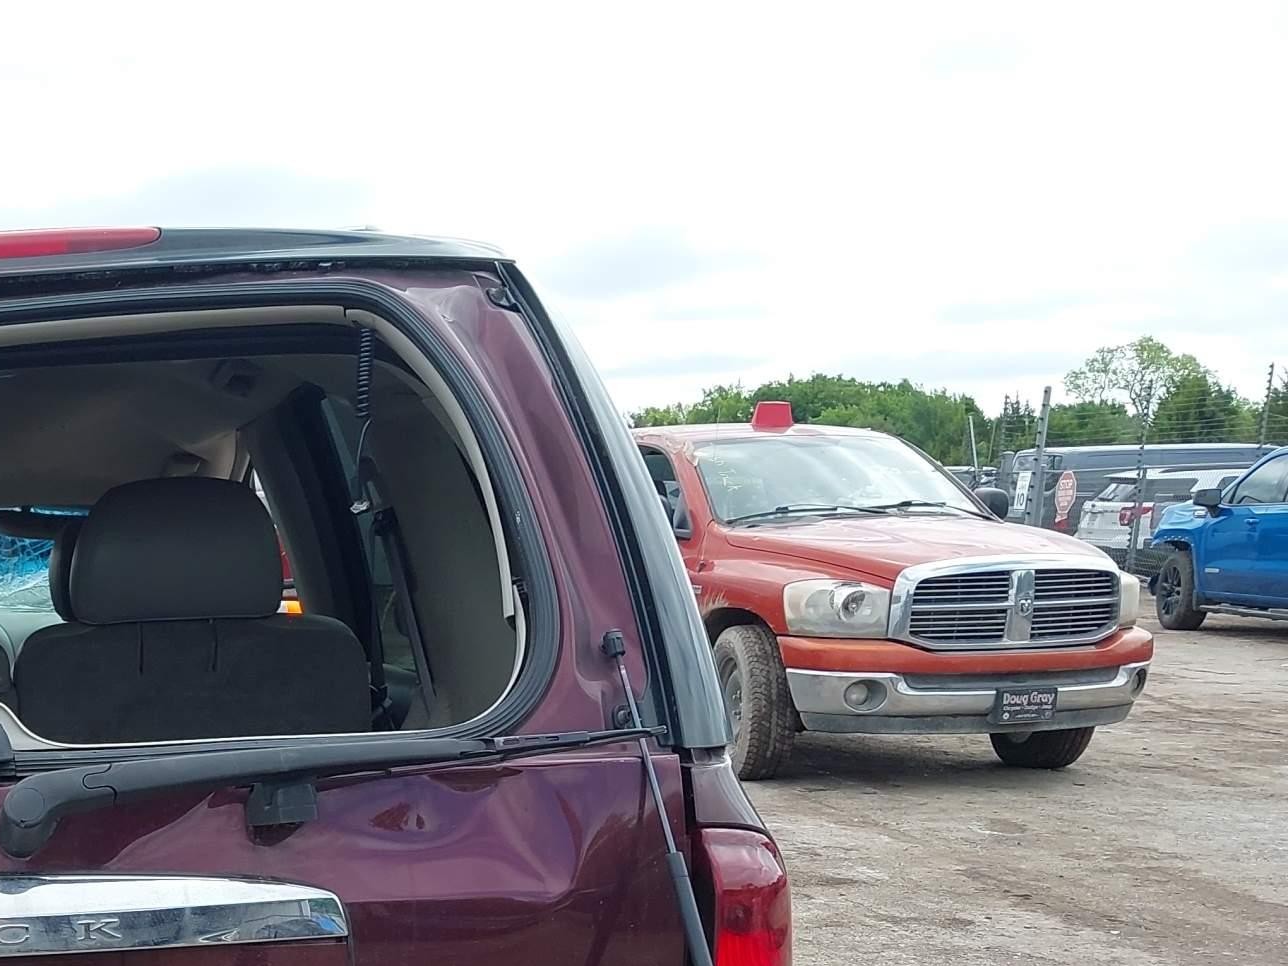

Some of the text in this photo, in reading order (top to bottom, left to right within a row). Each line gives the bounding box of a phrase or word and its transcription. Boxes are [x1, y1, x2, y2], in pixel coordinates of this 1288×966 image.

[1015, 493, 1025, 506] 10
[1002, 691, 1055, 705] Doug Gray
